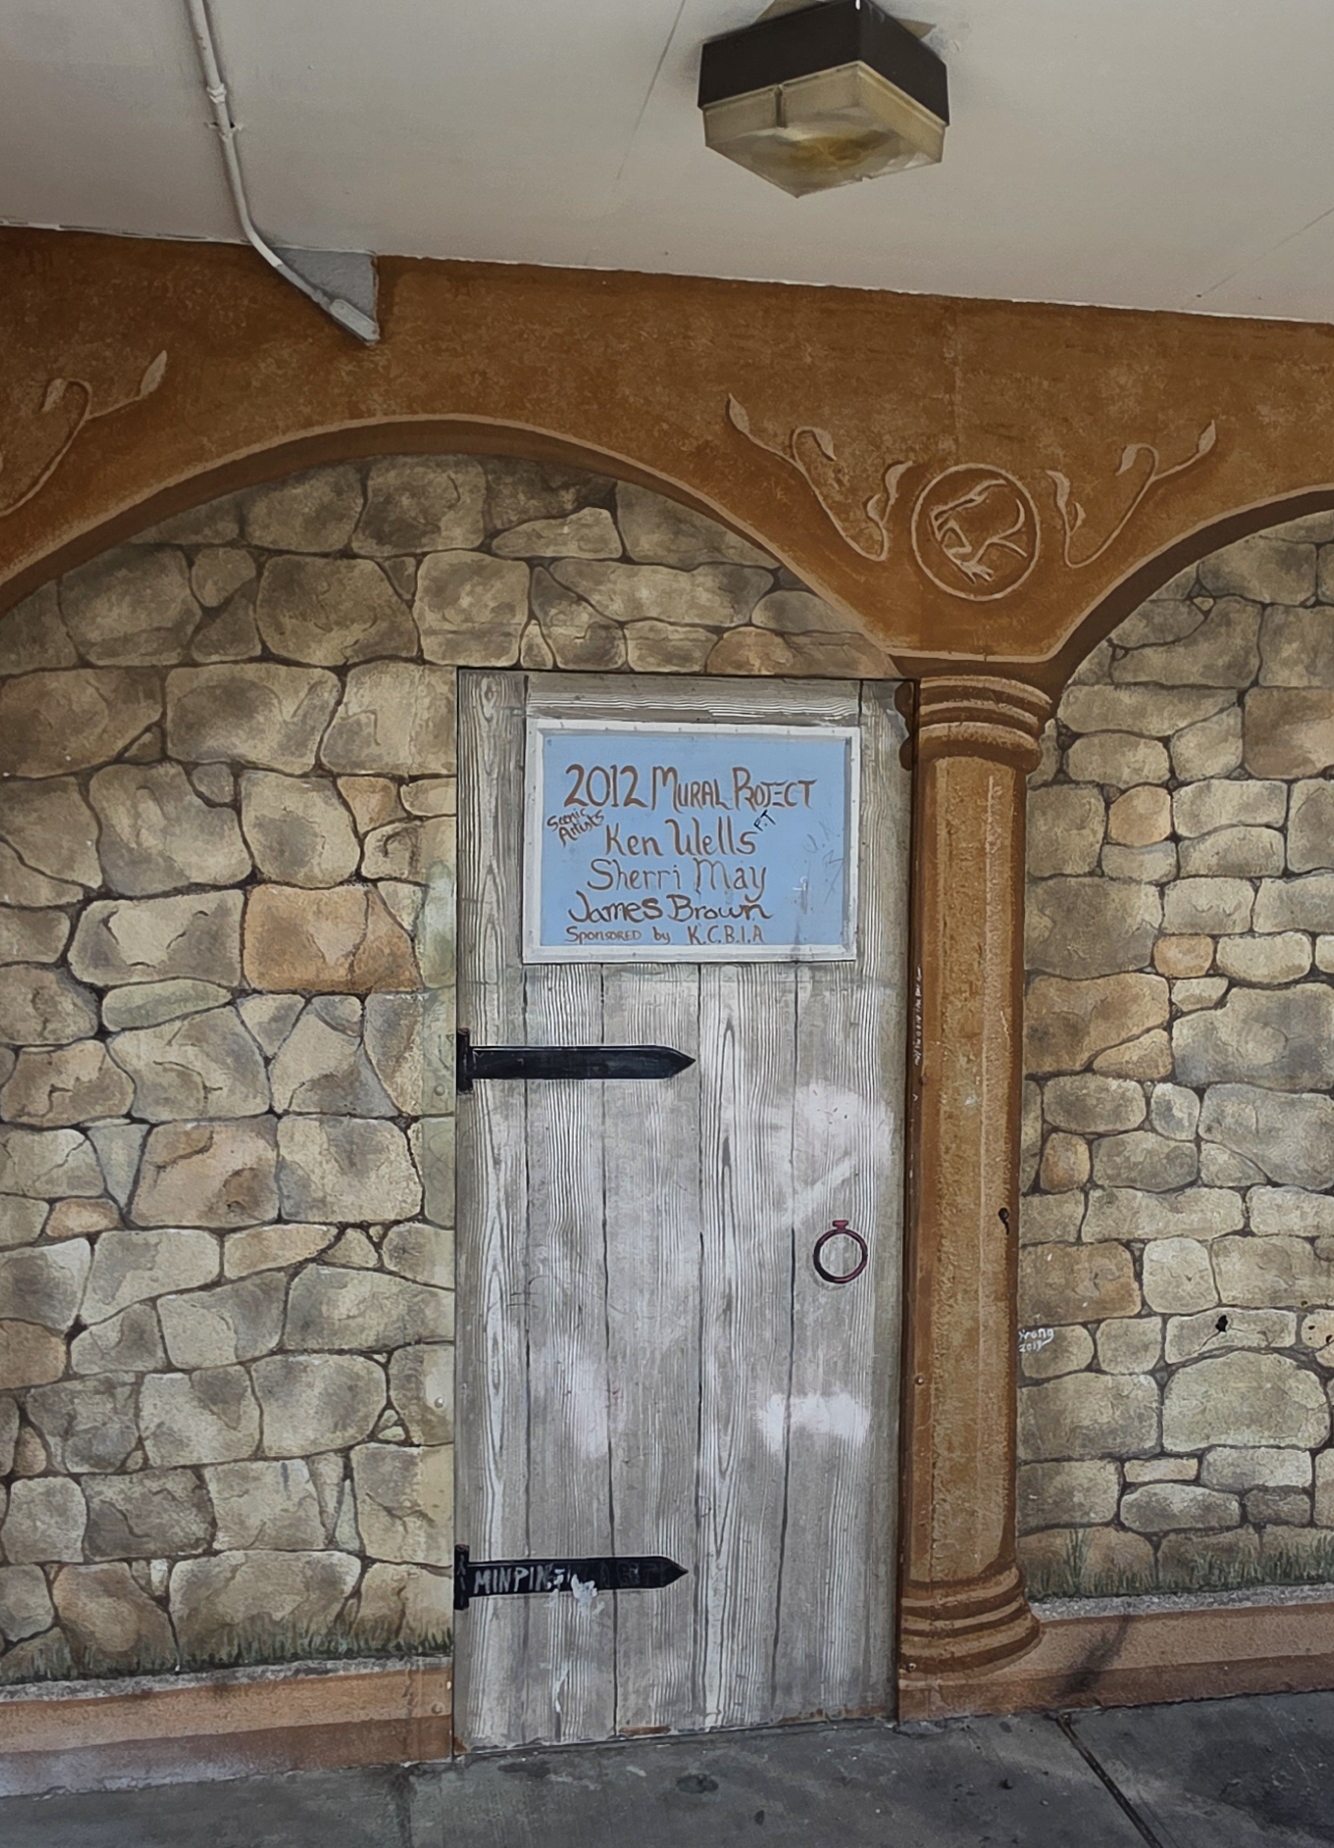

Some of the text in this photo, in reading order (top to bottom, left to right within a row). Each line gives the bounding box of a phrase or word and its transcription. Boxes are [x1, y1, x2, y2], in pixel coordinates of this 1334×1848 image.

[564, 764, 648, 808] 2012
[605, 815, 758, 856] Ken Wells
[586, 858, 681, 891] Sherri
[693, 857, 767, 904] May
[567, 890, 774, 923] James Brown
[652, 926, 671, 945] by
